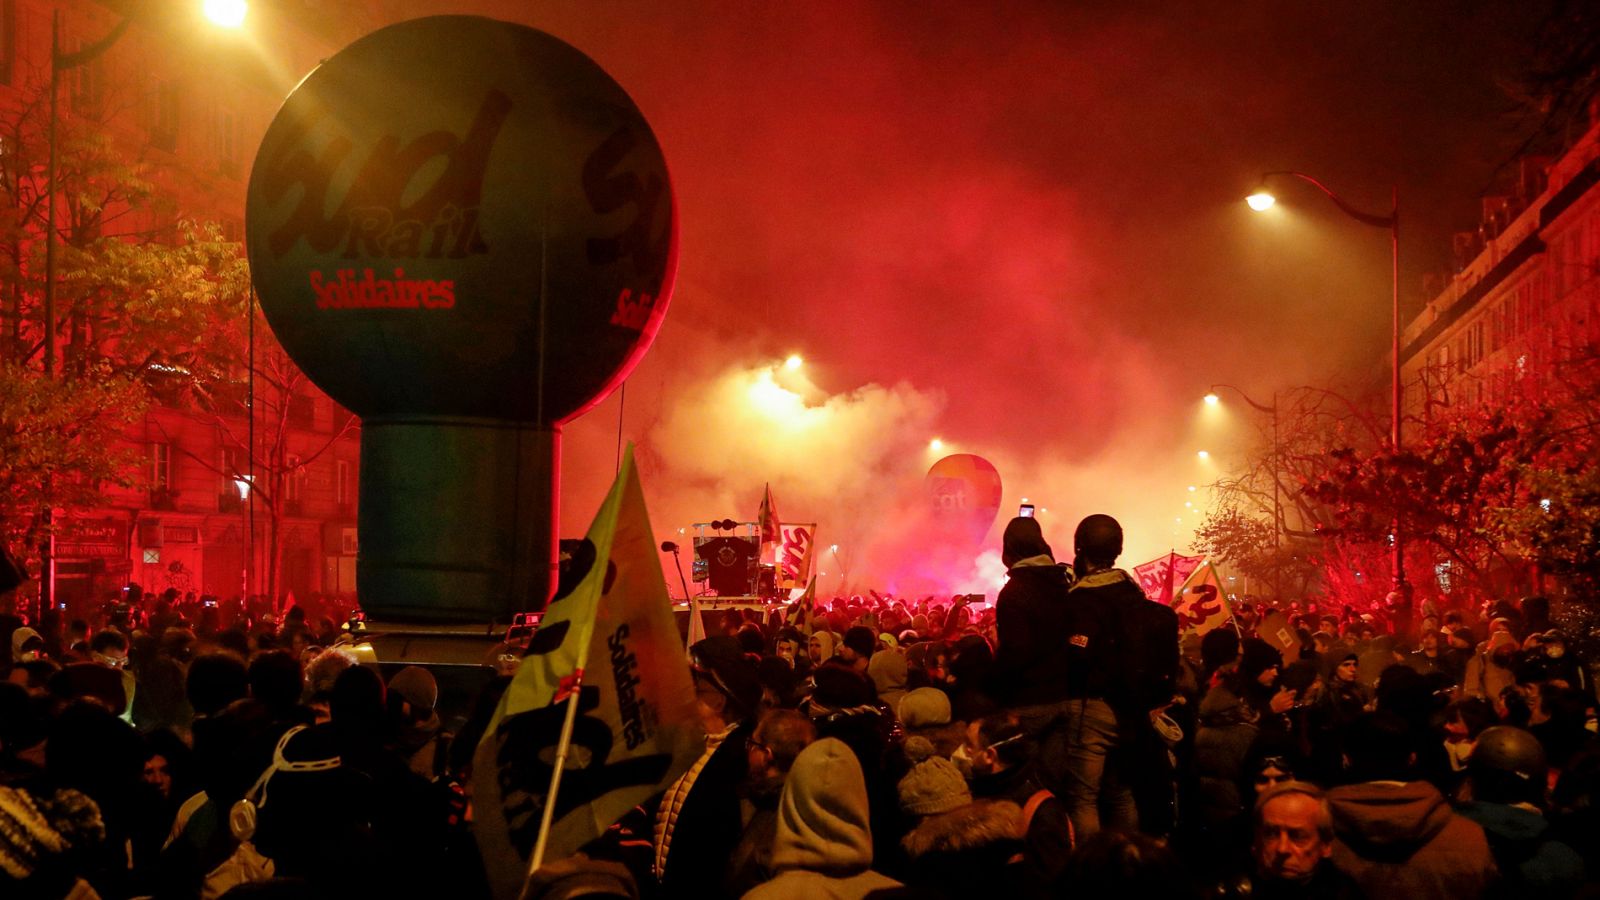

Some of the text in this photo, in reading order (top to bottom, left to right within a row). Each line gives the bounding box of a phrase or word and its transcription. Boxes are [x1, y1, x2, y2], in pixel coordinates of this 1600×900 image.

[340, 201, 490, 260] Rail
[307, 266, 456, 310] Solidaires
[607, 622, 646, 751] Solidaires
